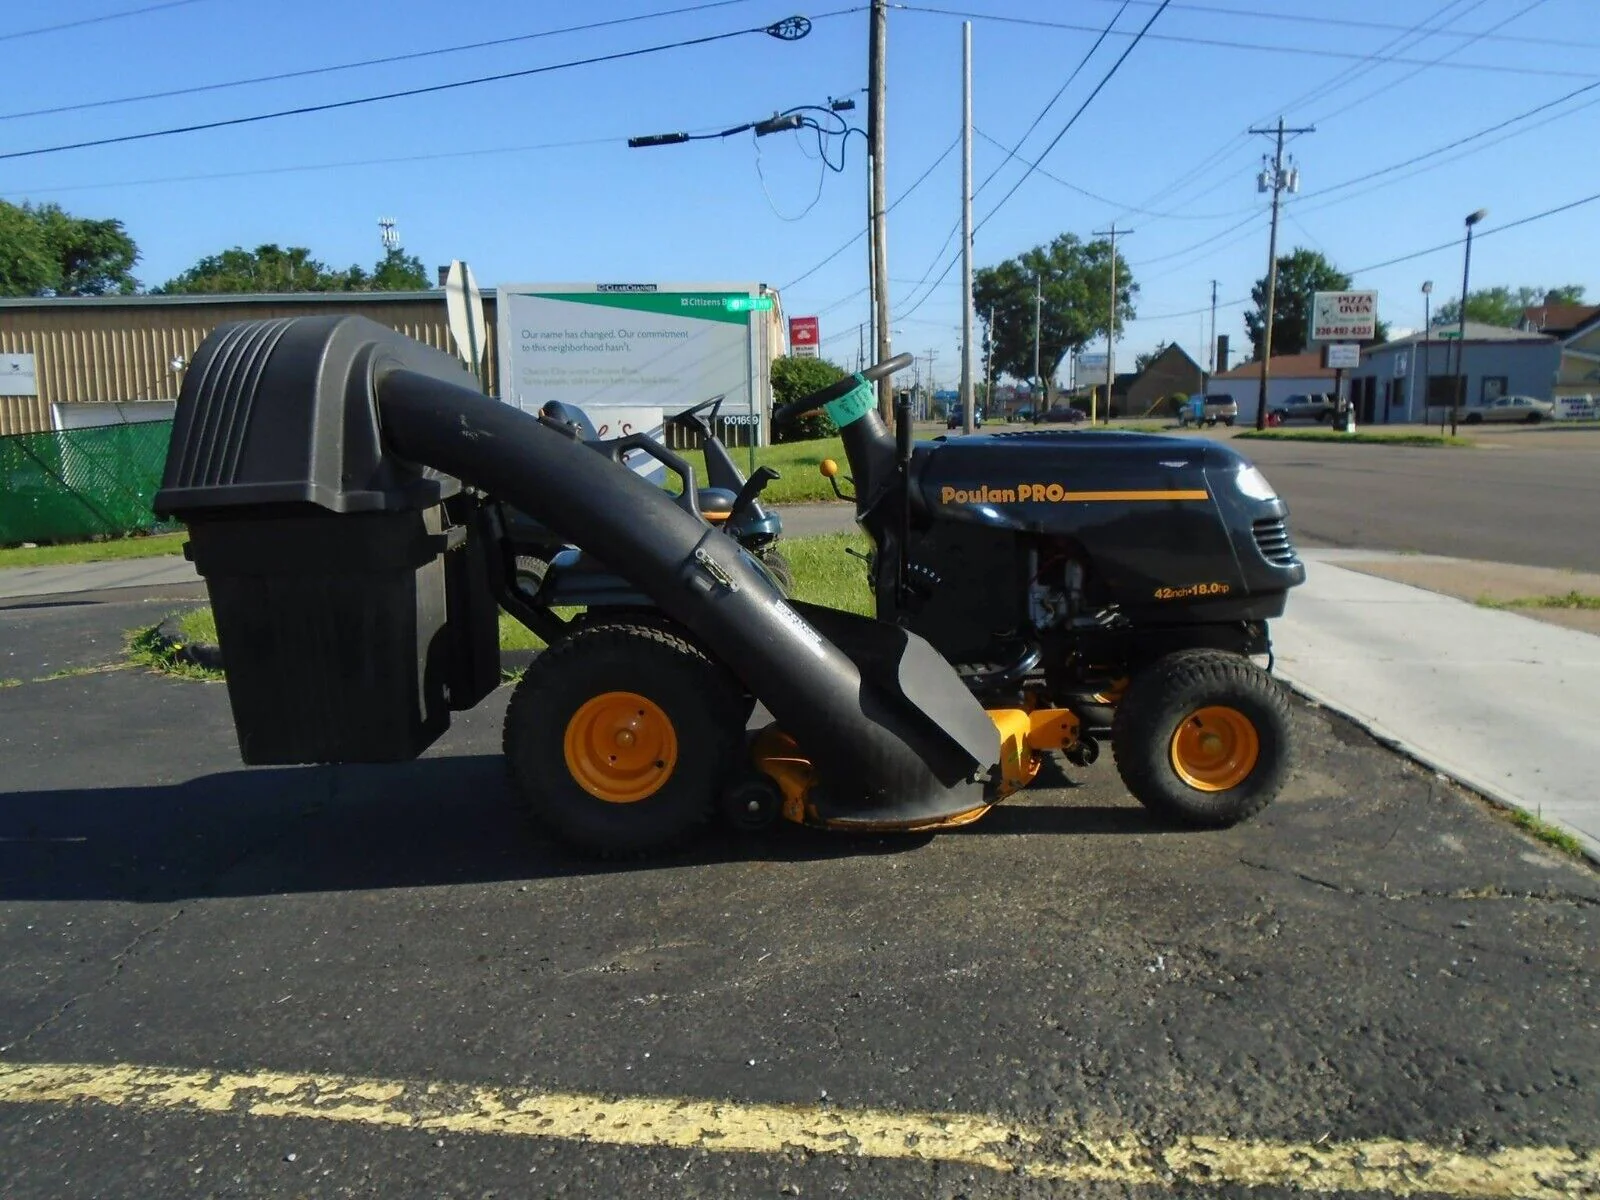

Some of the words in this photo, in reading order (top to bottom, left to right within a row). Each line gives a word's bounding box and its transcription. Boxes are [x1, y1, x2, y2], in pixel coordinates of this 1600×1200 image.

[689, 298, 721, 306] Citizens
[1338, 295, 1372, 303] PIZZA
[521, 329, 538, 339] Our
[540, 331, 563, 339] name
[564, 329, 578, 339] has
[580, 329, 616, 341] changed.
[617, 329, 634, 338] Our
[637, 330, 689, 338] commitment
[521, 344, 529, 352] to
[531, 343, 546, 352] this
[547, 343, 604, 354] neighborhood
[941, 485, 1016, 504] Poulan
[1017, 483, 1065, 503] PRO
